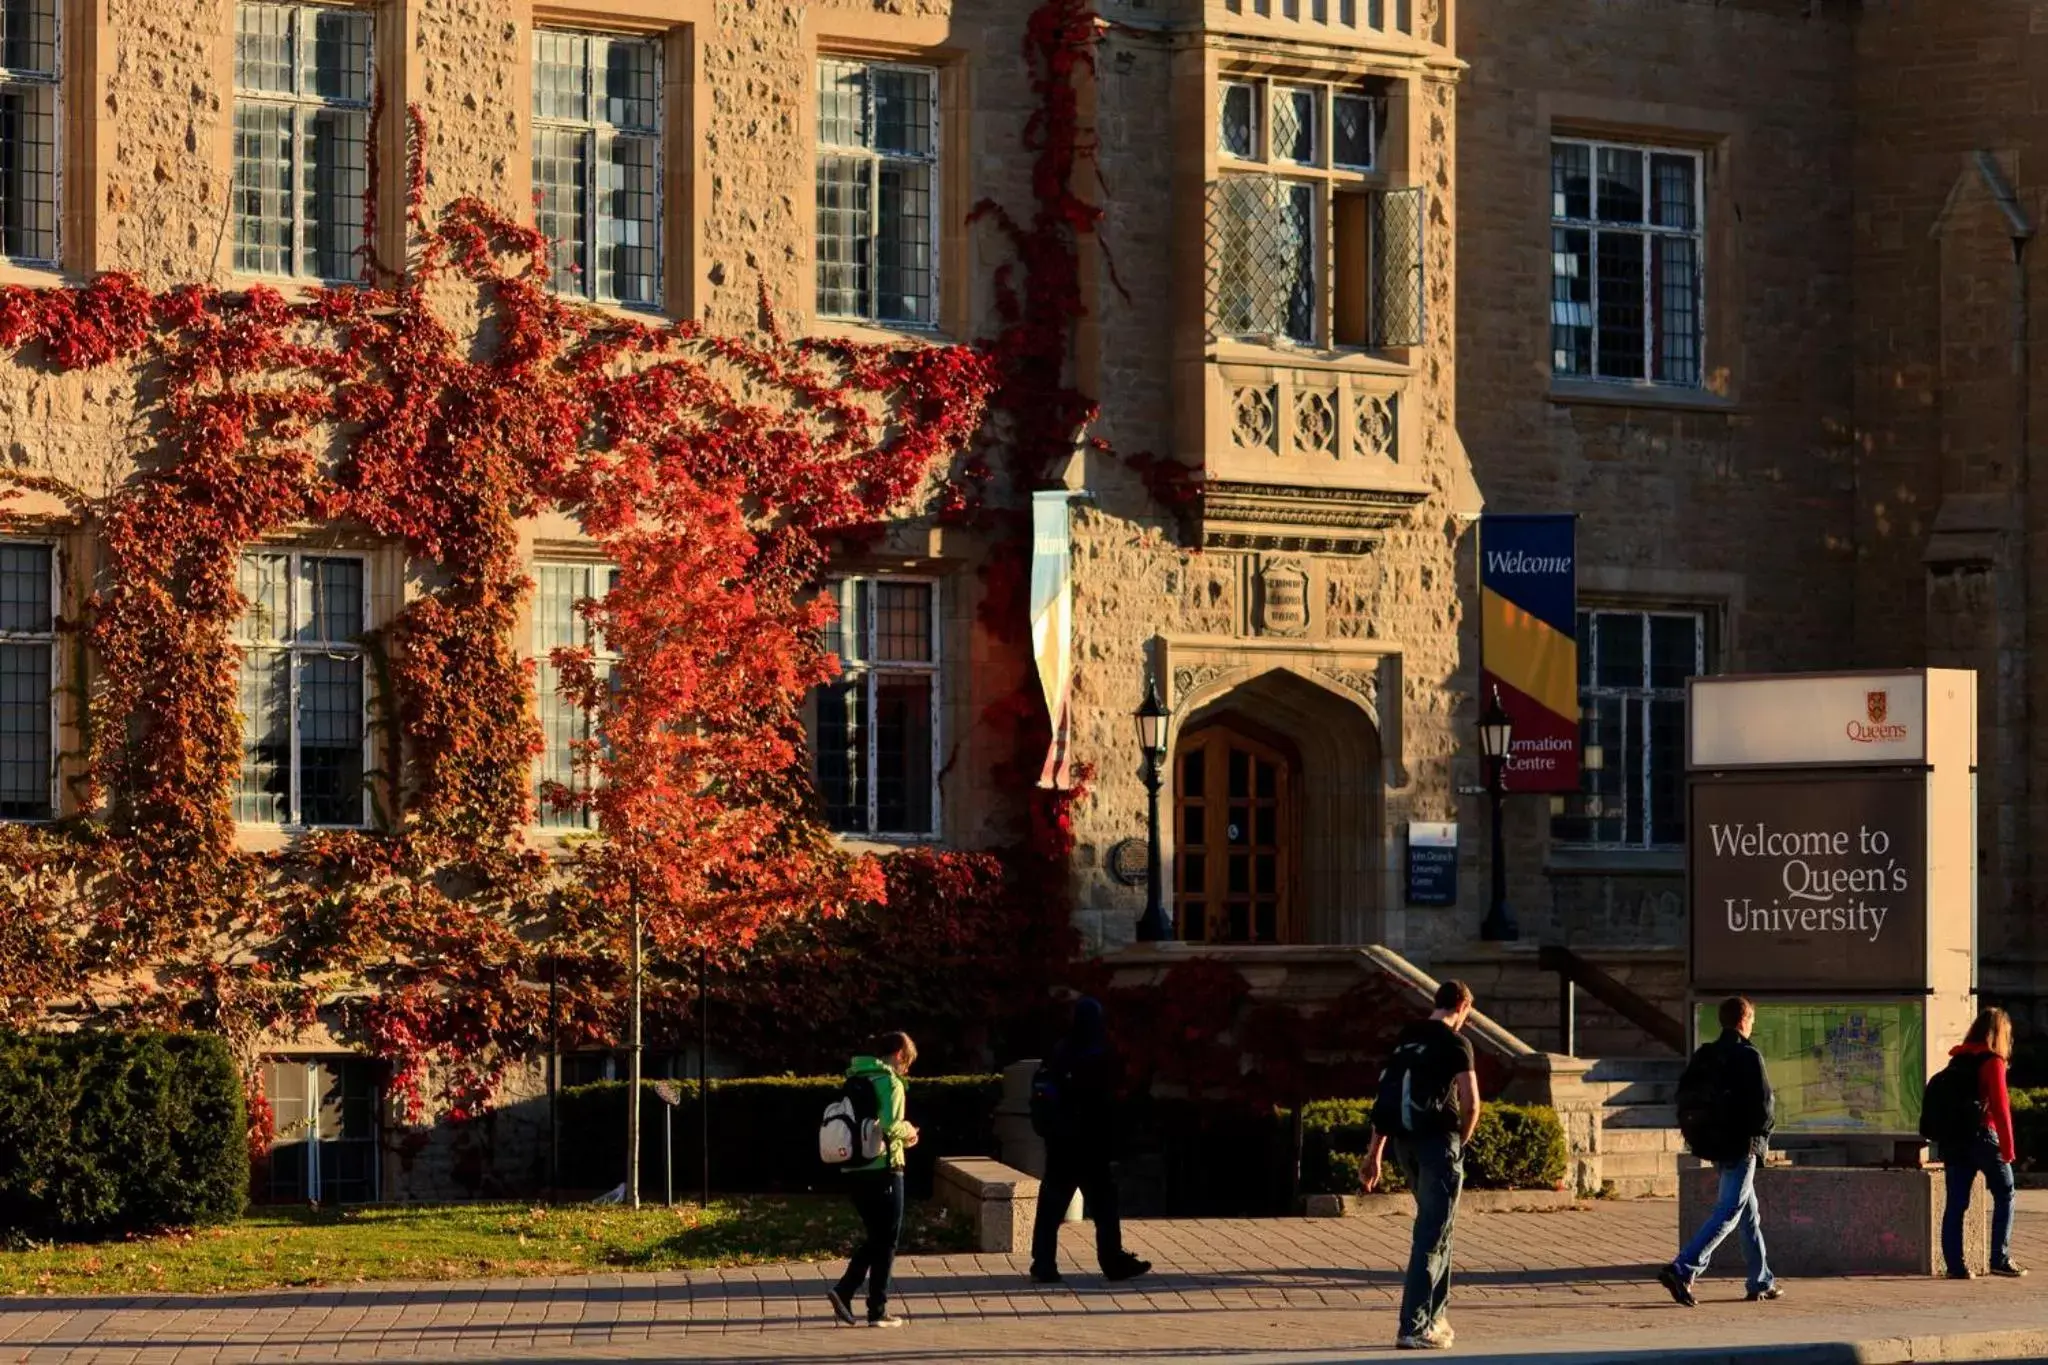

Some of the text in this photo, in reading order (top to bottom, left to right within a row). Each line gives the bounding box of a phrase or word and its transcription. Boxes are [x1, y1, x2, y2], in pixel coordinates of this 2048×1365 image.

[1487, 550, 1571, 574] Welcome
[1511, 736, 1573, 751] ormation
[1506, 754, 1556, 770] Centre
[1709, 823, 1889, 857] Welcome to
[1783, 858, 1907, 902] Queen's
[1725, 898, 1888, 942] University
